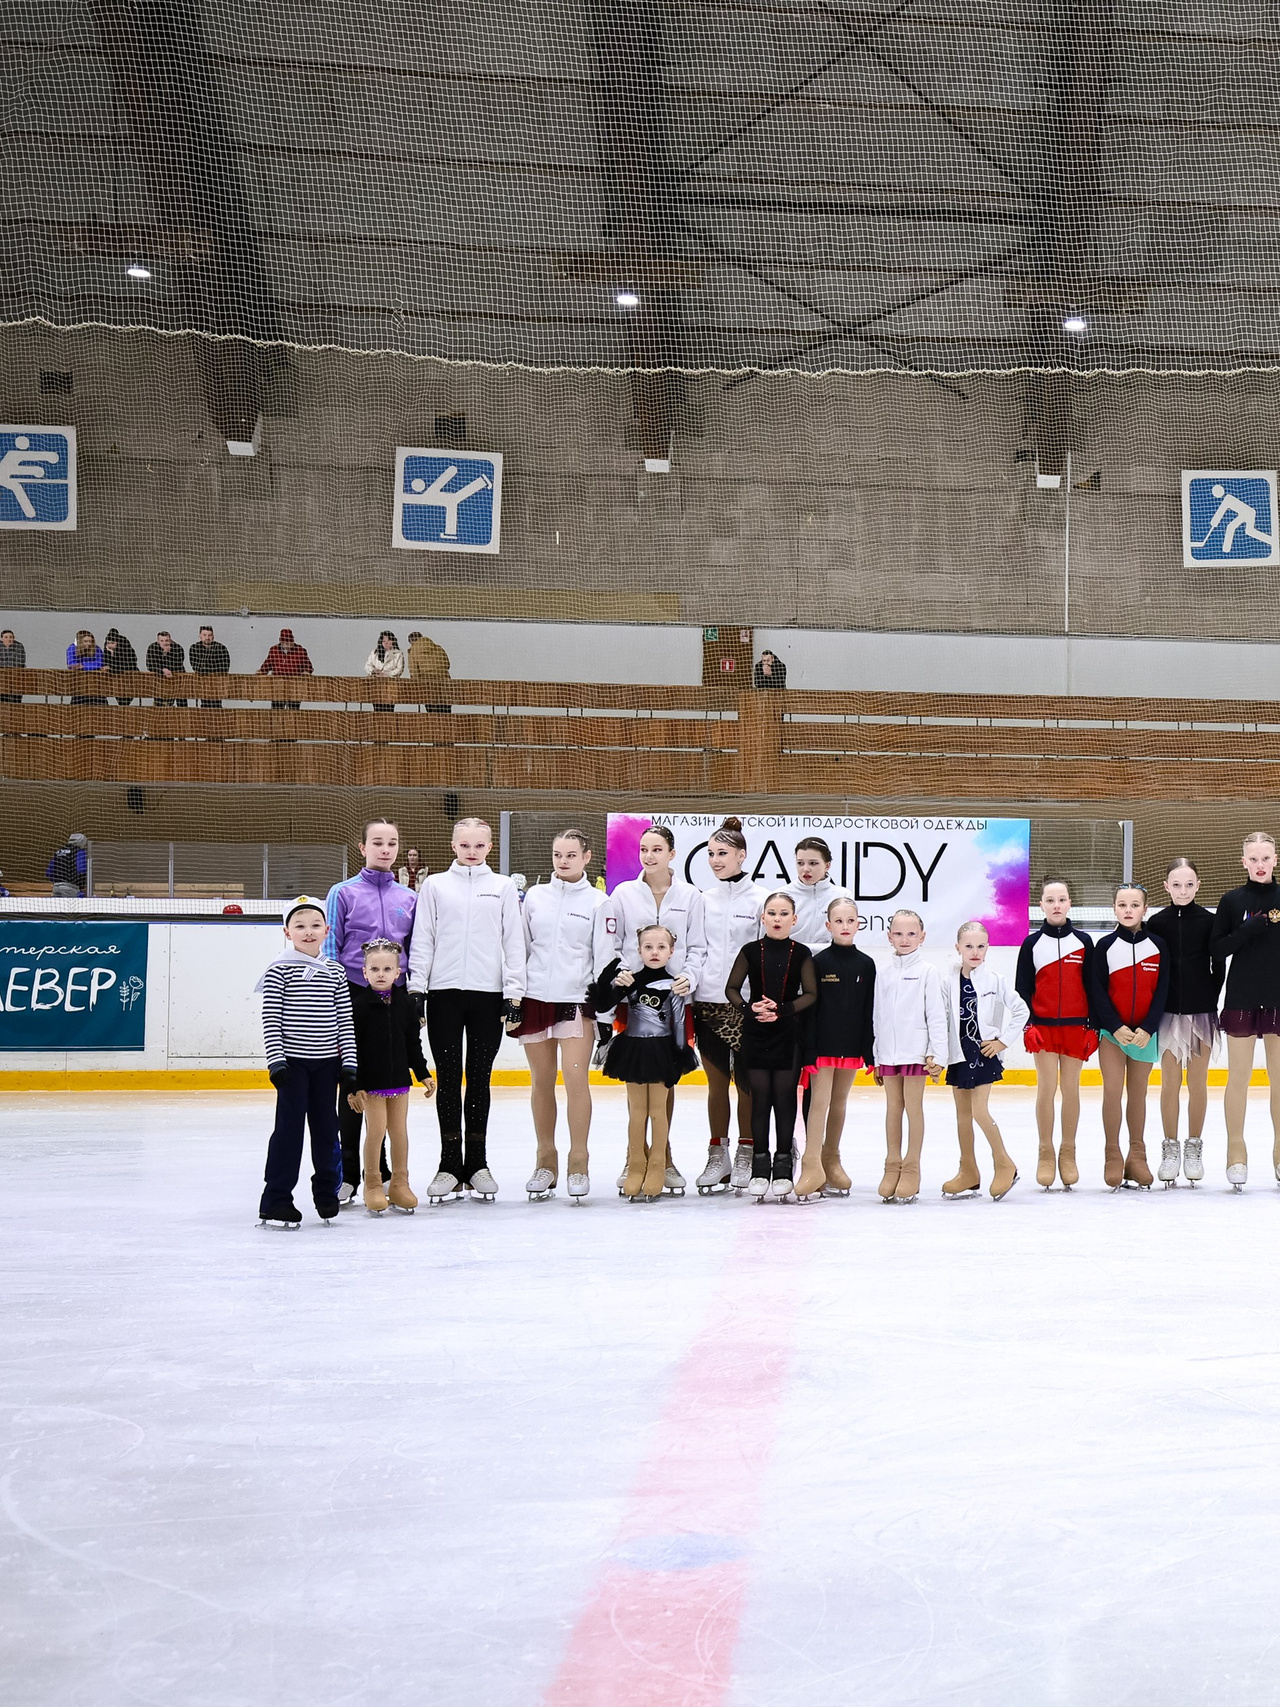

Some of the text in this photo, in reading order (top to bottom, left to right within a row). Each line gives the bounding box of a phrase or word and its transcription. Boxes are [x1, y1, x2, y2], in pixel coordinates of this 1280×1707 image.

[651, 815, 988, 831] МАГАЗИН ТСКОЙ И ПОДРОСТКОВОЙ ОДЕЖДЫ
[0, 967, 117, 1012] ЕВЕР
